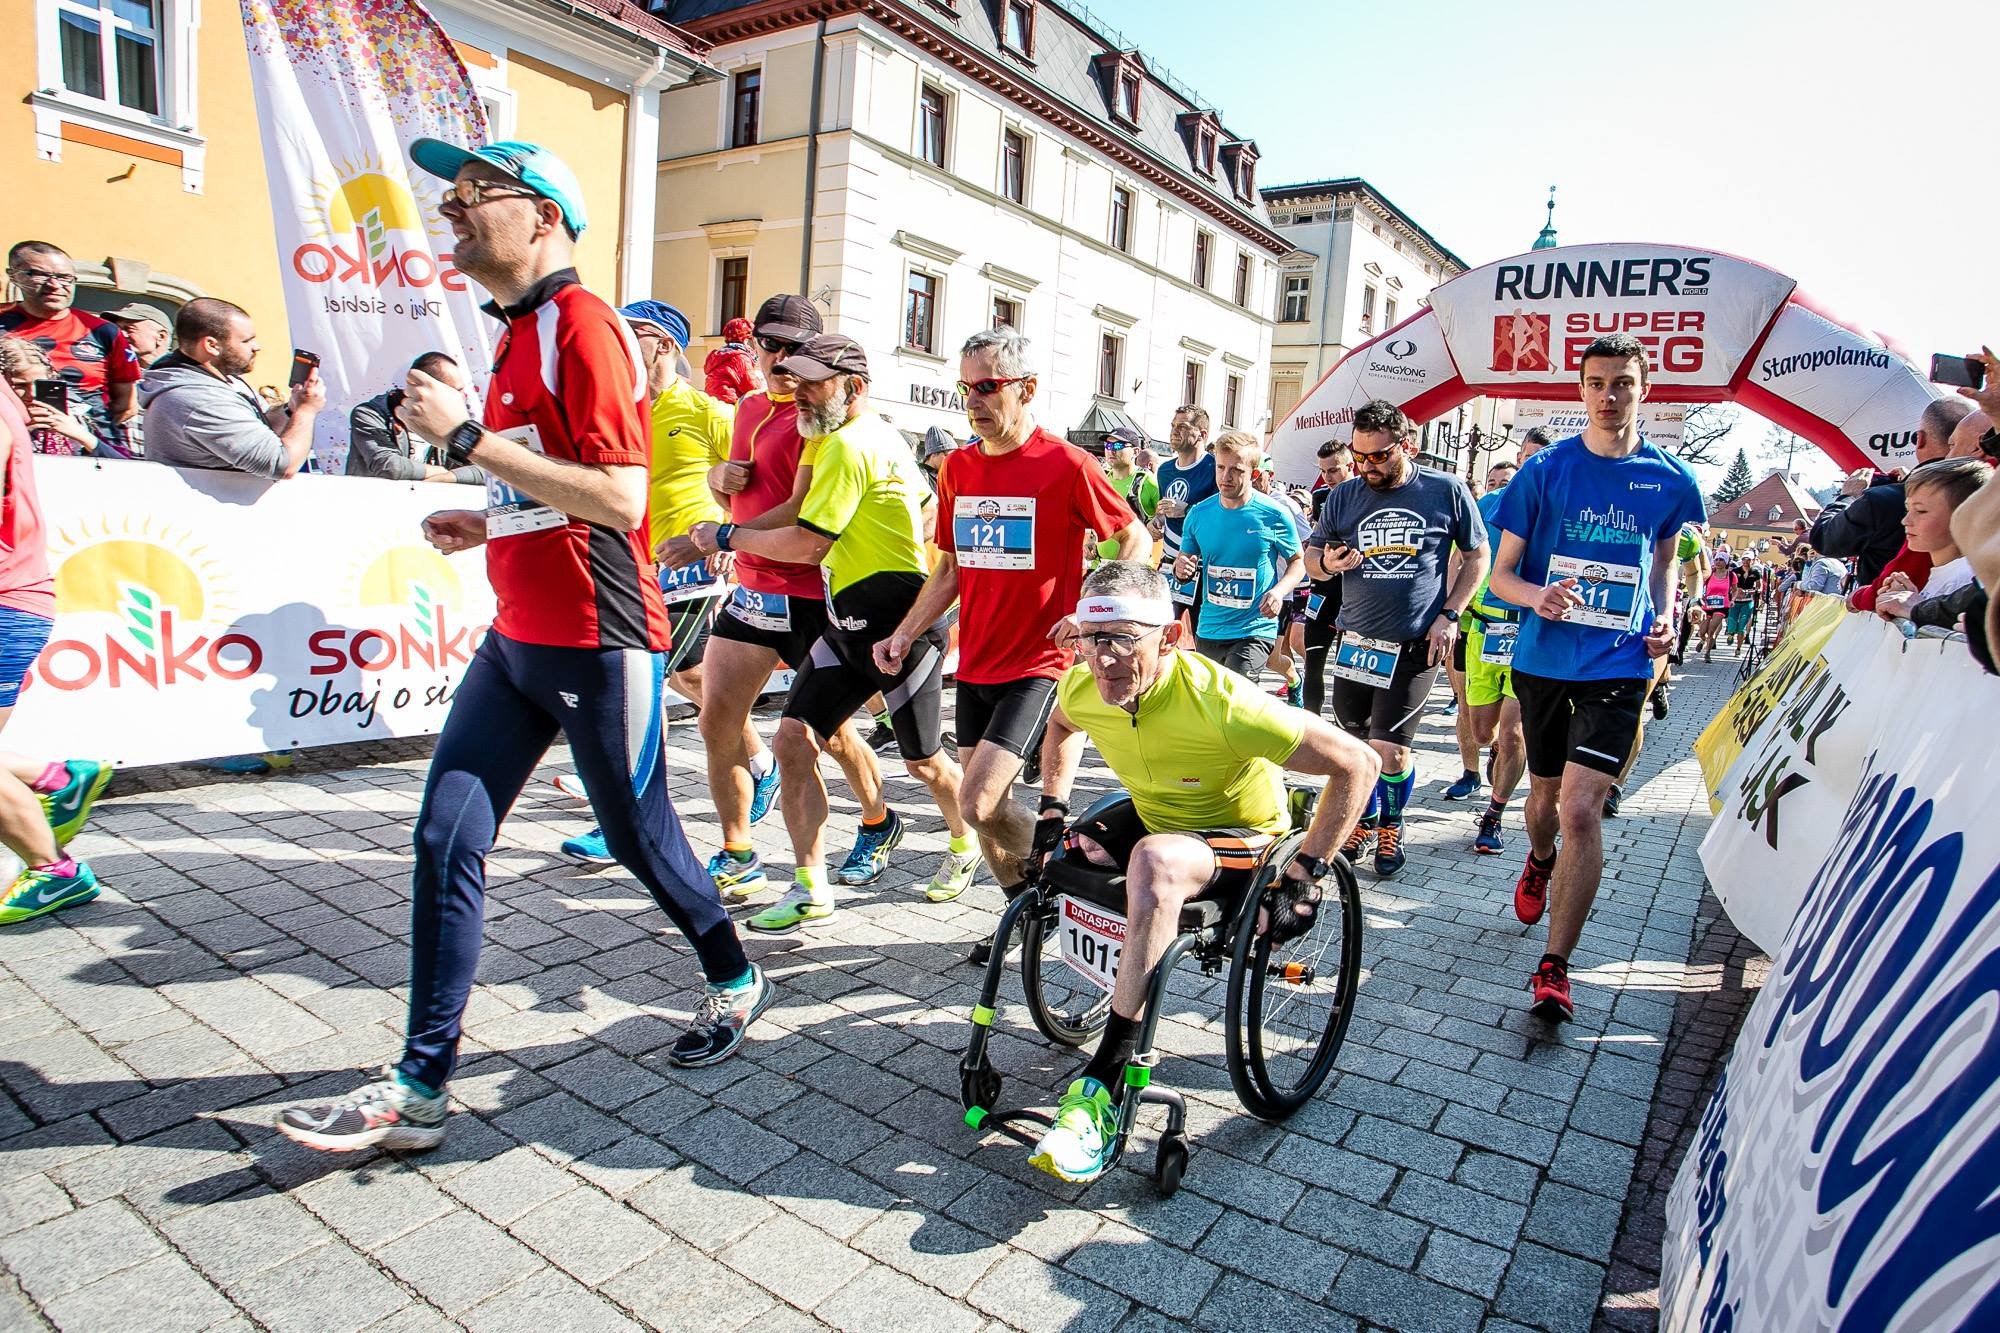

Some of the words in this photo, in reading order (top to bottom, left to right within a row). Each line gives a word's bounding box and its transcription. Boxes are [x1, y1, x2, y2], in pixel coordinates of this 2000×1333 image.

[1495, 257, 1712, 301] RUNNER'S
[1683, 288, 1707, 296] WORLD
[1566, 311, 1705, 333] SUPER
[1564, 336, 1704, 373] BG
[1762, 345, 1890, 382] Staropolanka
[970, 524, 1005, 547] 121
[1358, 528, 1425, 552] BIEG
[668, 564, 703, 586] 471
[1216, 581, 1239, 597] 241
[20, 610, 263, 694] ONKO
[1350, 650, 1379, 670] 410
[289, 678, 382, 729] Dbaj
[393, 686, 411, 709] o
